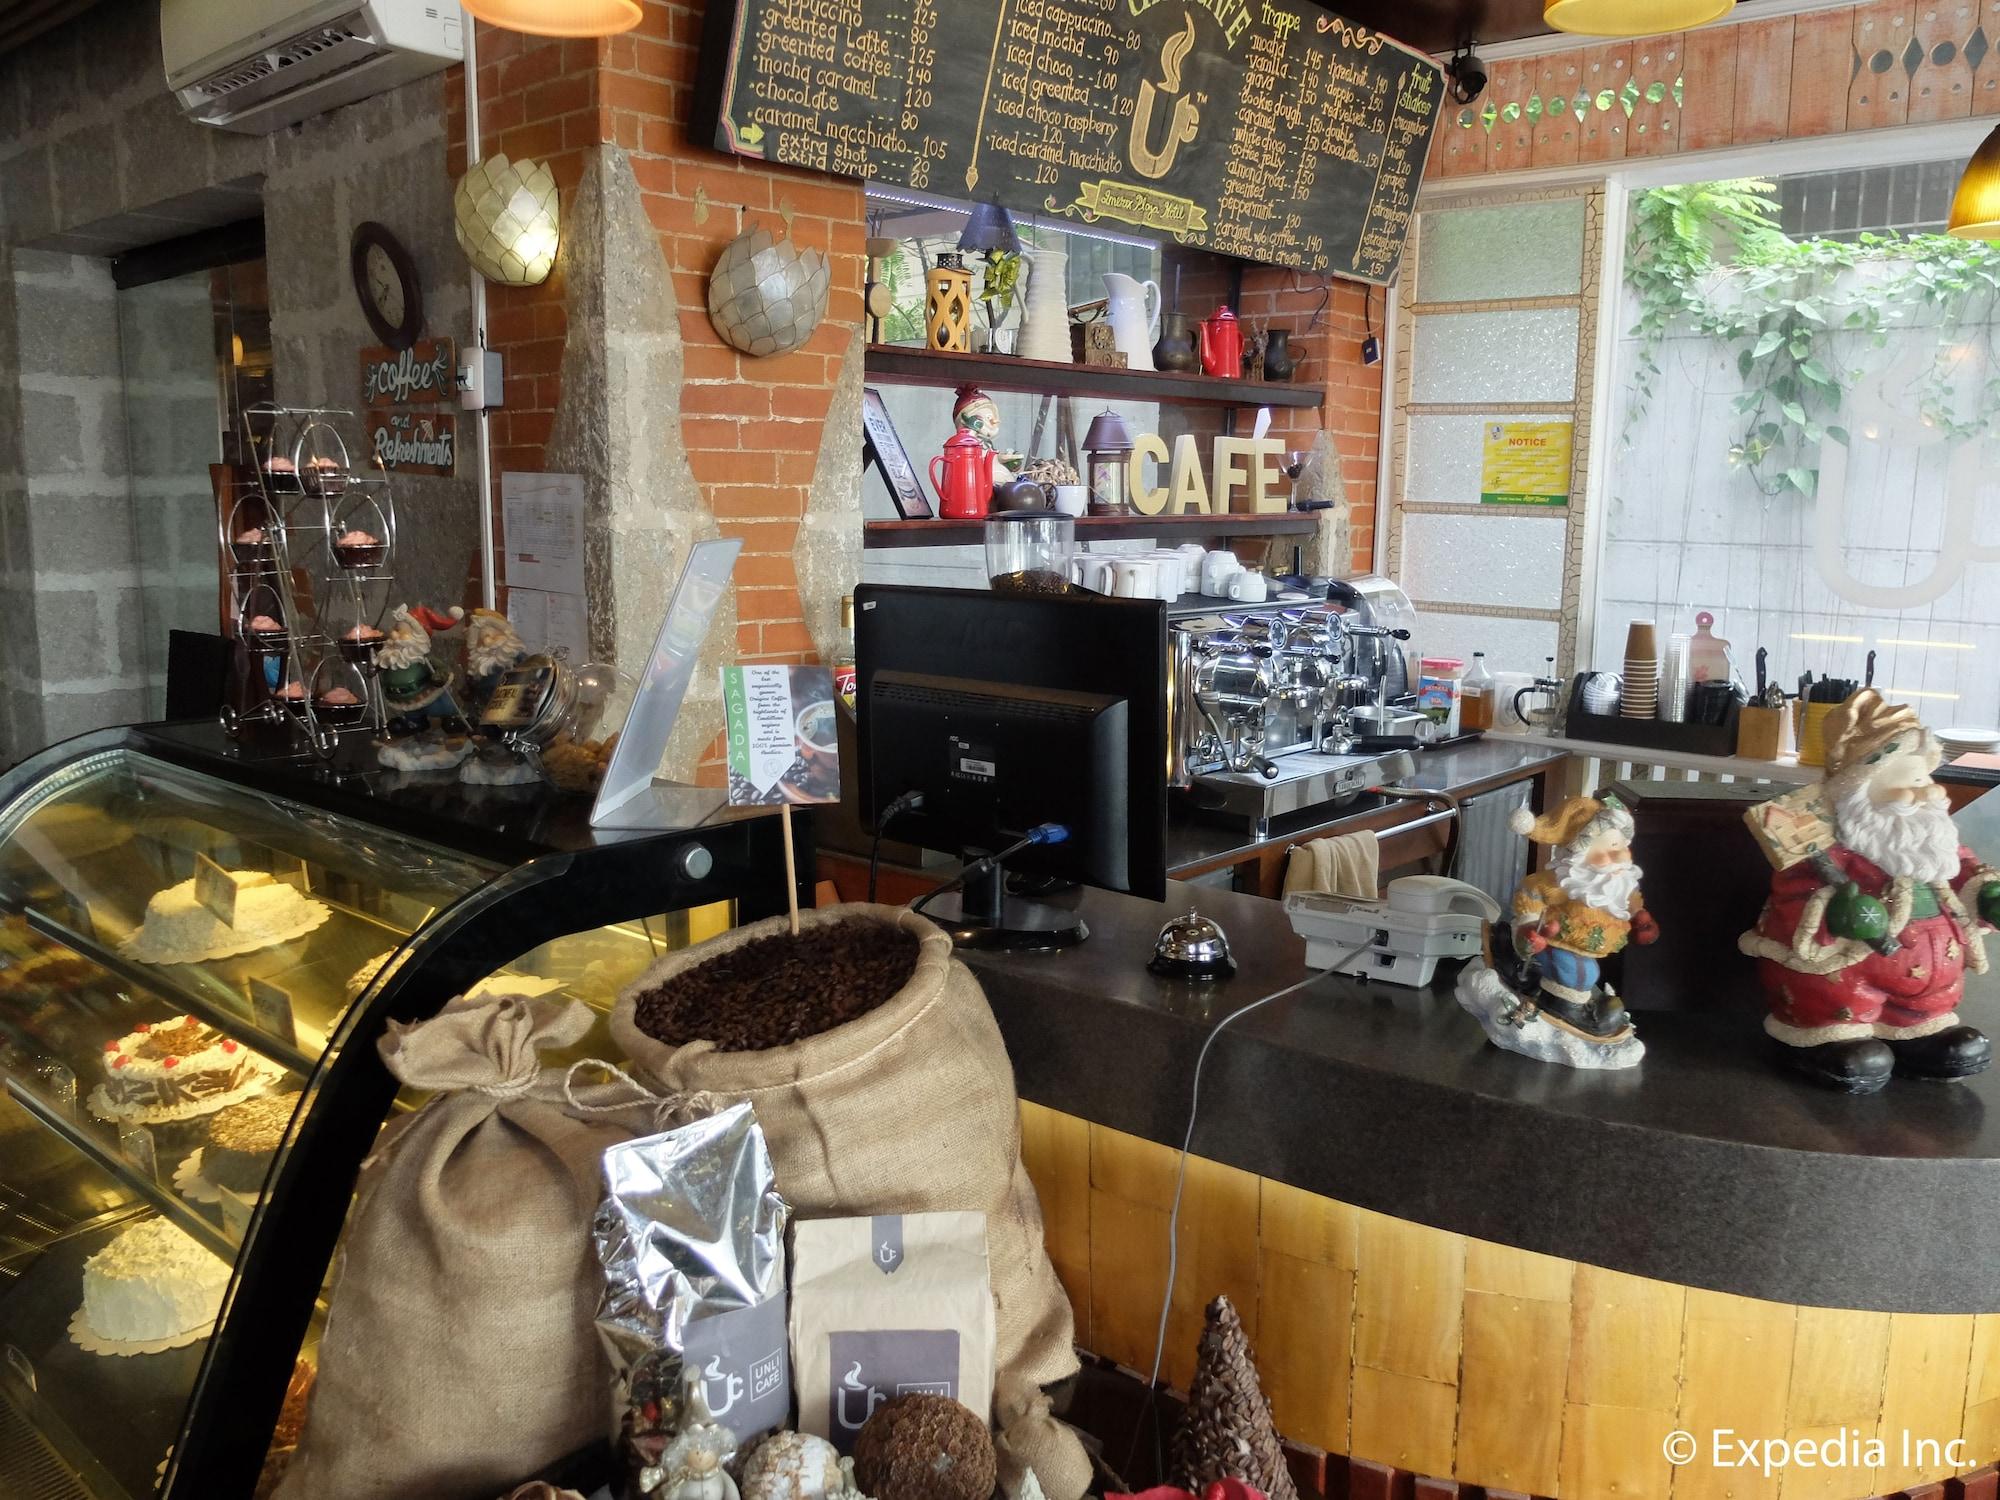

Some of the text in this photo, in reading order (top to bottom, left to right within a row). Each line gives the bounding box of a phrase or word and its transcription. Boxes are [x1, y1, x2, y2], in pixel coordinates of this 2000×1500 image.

[762, 8, 837, 42] greentea
[908, 45, 936, 66] 125
[911, 26, 928, 44] 80
[913, 8, 937, 28] 125
[1045, 5, 1112, 37] cappuccino
[1125, 29, 1141, 50] 80
[757, 31, 932, 86] greentea coffee 140
[1010, 14, 1119, 66] iced mocha 90
[1304, 48, 1324, 70] 145
[758, 55, 932, 108] mocha caramel 120
[1006, 41, 1118, 91] iced choco 100
[1249, 53, 1319, 88] vanilla 140
[1408, 62, 1433, 94] fruit
[756, 76, 918, 131] chocolate 80
[1001, 67, 1134, 116] iced greentea 120
[1274, 93, 1302, 129] dough
[1299, 88, 1317, 105] 150
[754, 106, 949, 160] caramel macchiato 105
[995, 94, 1119, 147] iced choco raspberry
[1042, 124, 1063, 144] 120
[1238, 107, 1276, 133] caramel
[779, 132, 930, 173] extra shot 20
[990, 130, 1123, 174] iced caramel macchiato
[1231, 143, 1314, 185] coffee jelly 150
[1235, 124, 1317, 169] white choco 150
[776, 147, 929, 189] extra syrup 20
[1034, 164, 1059, 184] 120
[1227, 158, 1263, 184] almond
[1291, 184, 1309, 200] 150
[1219, 197, 1274, 221] peppermint
[1254, 245, 1274, 262] and
[390, 413, 410, 428] and
[374, 426, 452, 467] Refreshments
[1509, 438, 1547, 446] NOTICE
[755, 1355, 780, 1379] UNLI
